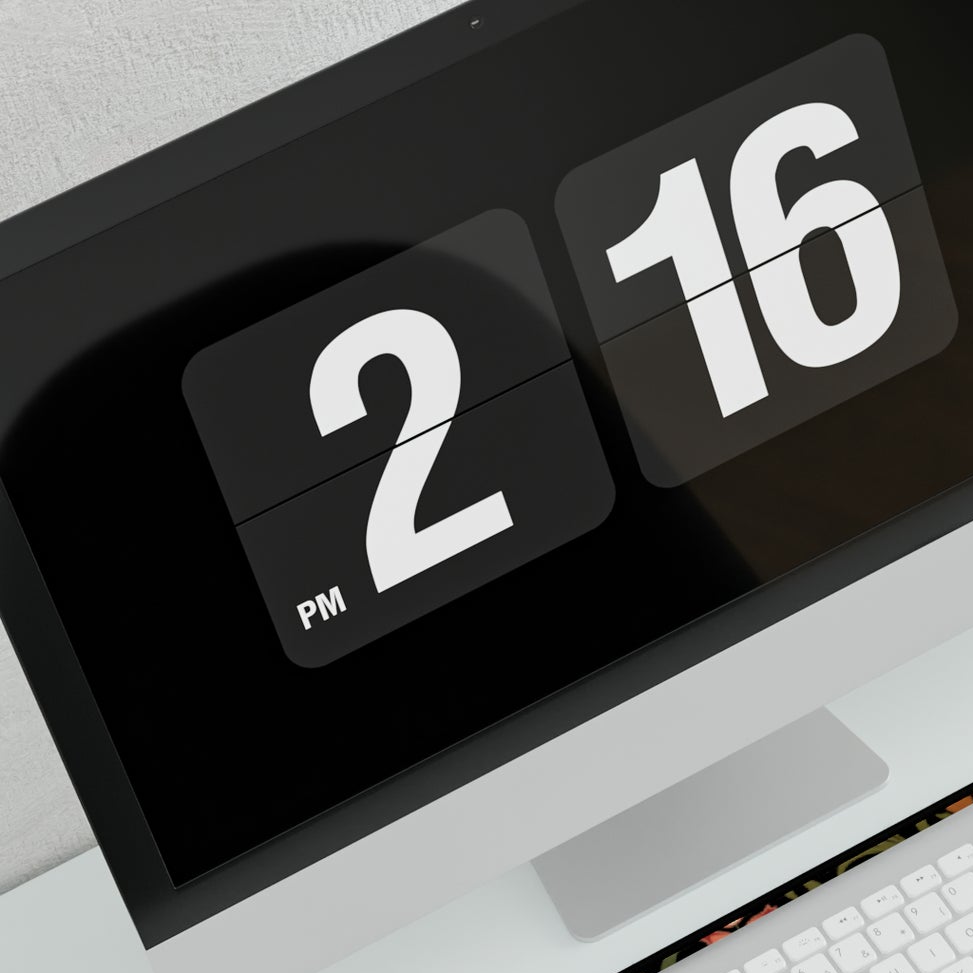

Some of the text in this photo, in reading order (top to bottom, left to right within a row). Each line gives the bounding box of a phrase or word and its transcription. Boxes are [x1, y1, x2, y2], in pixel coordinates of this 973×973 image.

[309, 103, 901, 593] 2 16
[297, 586, 346, 630] PM
[947, 886, 958, 896] 0
[910, 907, 918, 917] 9
[872, 927, 882, 937] 8
[834, 947, 842, 958] 7
